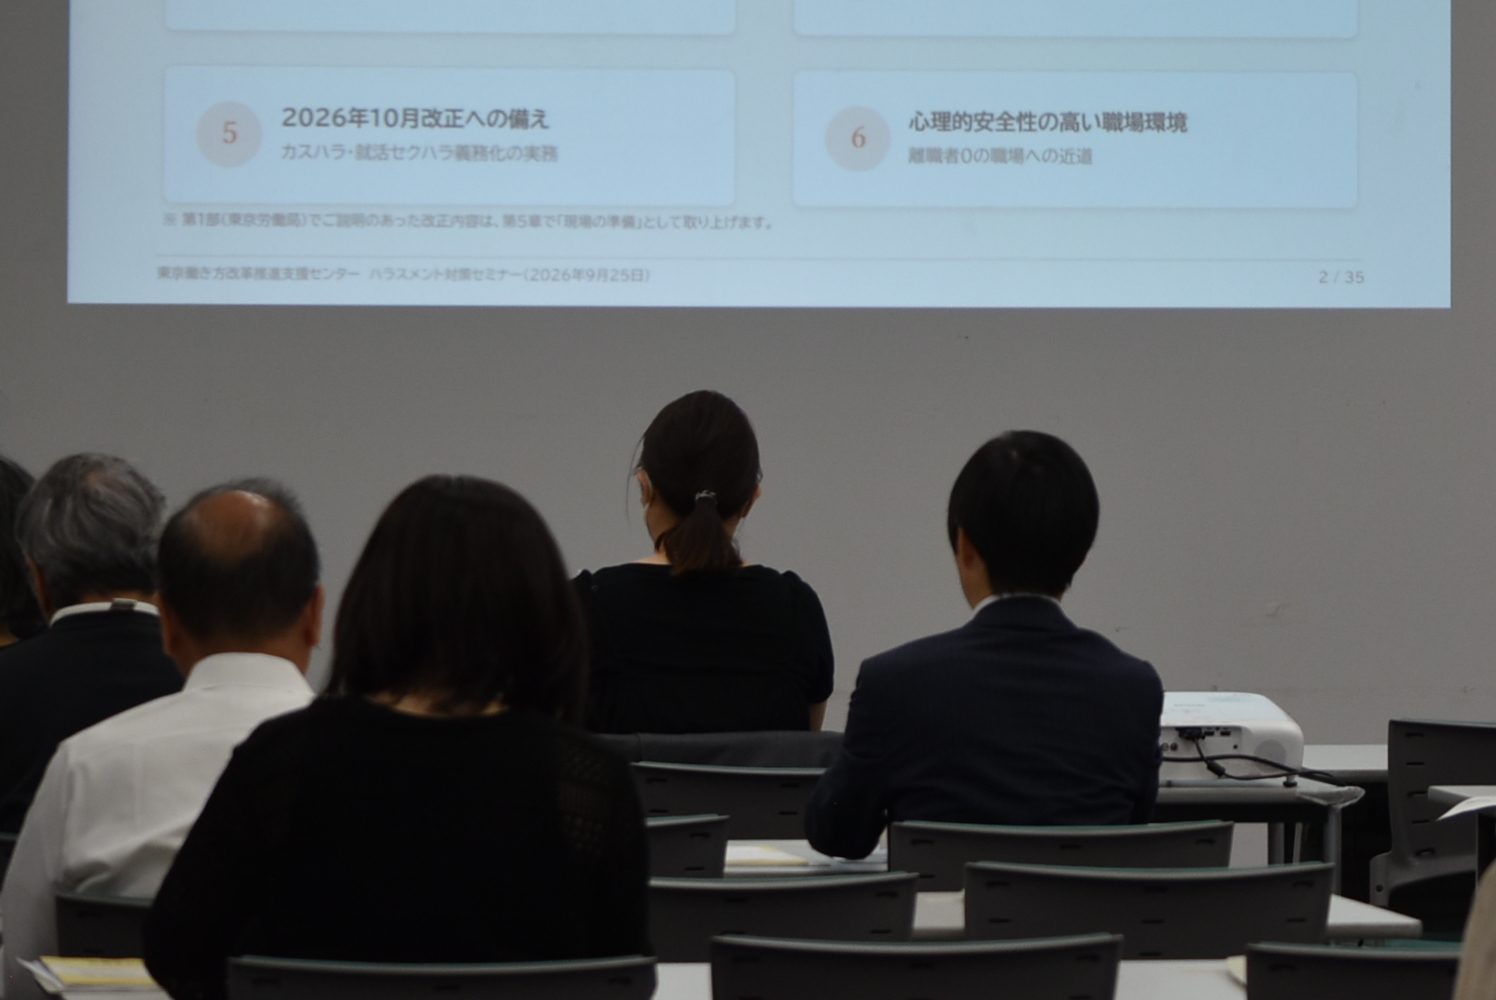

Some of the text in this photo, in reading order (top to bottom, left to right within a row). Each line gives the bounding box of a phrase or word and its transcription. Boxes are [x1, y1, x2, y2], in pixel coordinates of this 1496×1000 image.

[281, 107, 550, 130] 2026年10月改正への備え
[909, 110, 1188, 134] 心理的安全性の高い職場環境
[222, 121, 238, 144] 5
[851, 125, 867, 149] 6
[281, 143, 558, 163] カスハラ・就活セクハラ義務化の実務
[908, 146, 1094, 165] 離職者0の職場への近道
[157, 264, 360, 281] 東京働き方改革推進支援センター
[1318, 270, 1328, 284] 2
[1345, 270, 1365, 284] 35
